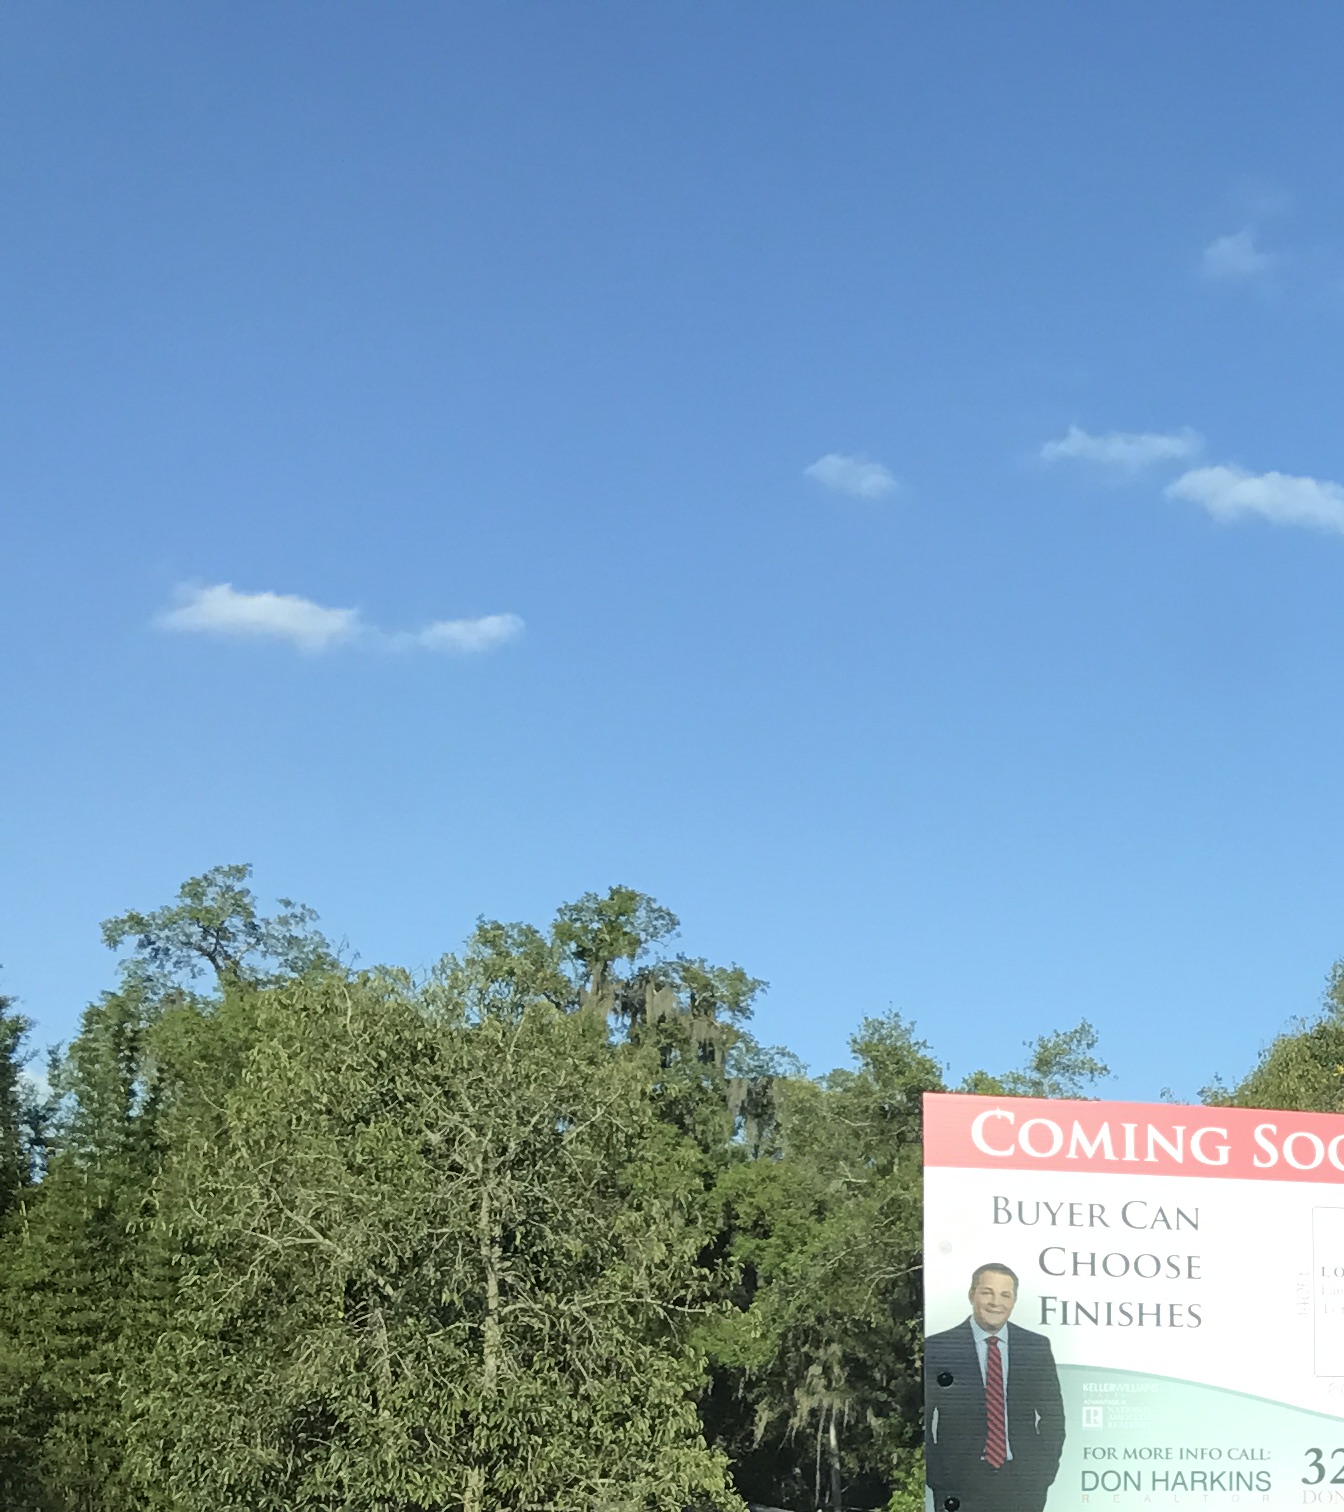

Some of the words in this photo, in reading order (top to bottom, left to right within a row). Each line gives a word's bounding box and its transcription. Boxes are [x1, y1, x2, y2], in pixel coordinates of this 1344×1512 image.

[971, 1107, 1232, 1166] COMING
[992, 1195, 1111, 1228] BUYER
[1121, 1200, 1200, 1231] CAN
[1038, 1246, 1202, 1280] CHOOSE
[1038, 1296, 1203, 1329] FINISHES
[1082, 1447, 1118, 1460] FOR
[1122, 1447, 1174, 1460] MORE
[1179, 1447, 1222, 1460] INFO
[1227, 1448, 1272, 1461] CALL:
[1081, 1470, 1141, 1492] DON
[1151, 1470, 1272, 1492] HARKINS
[1081, 1494, 1270, 1504] REALTOR
